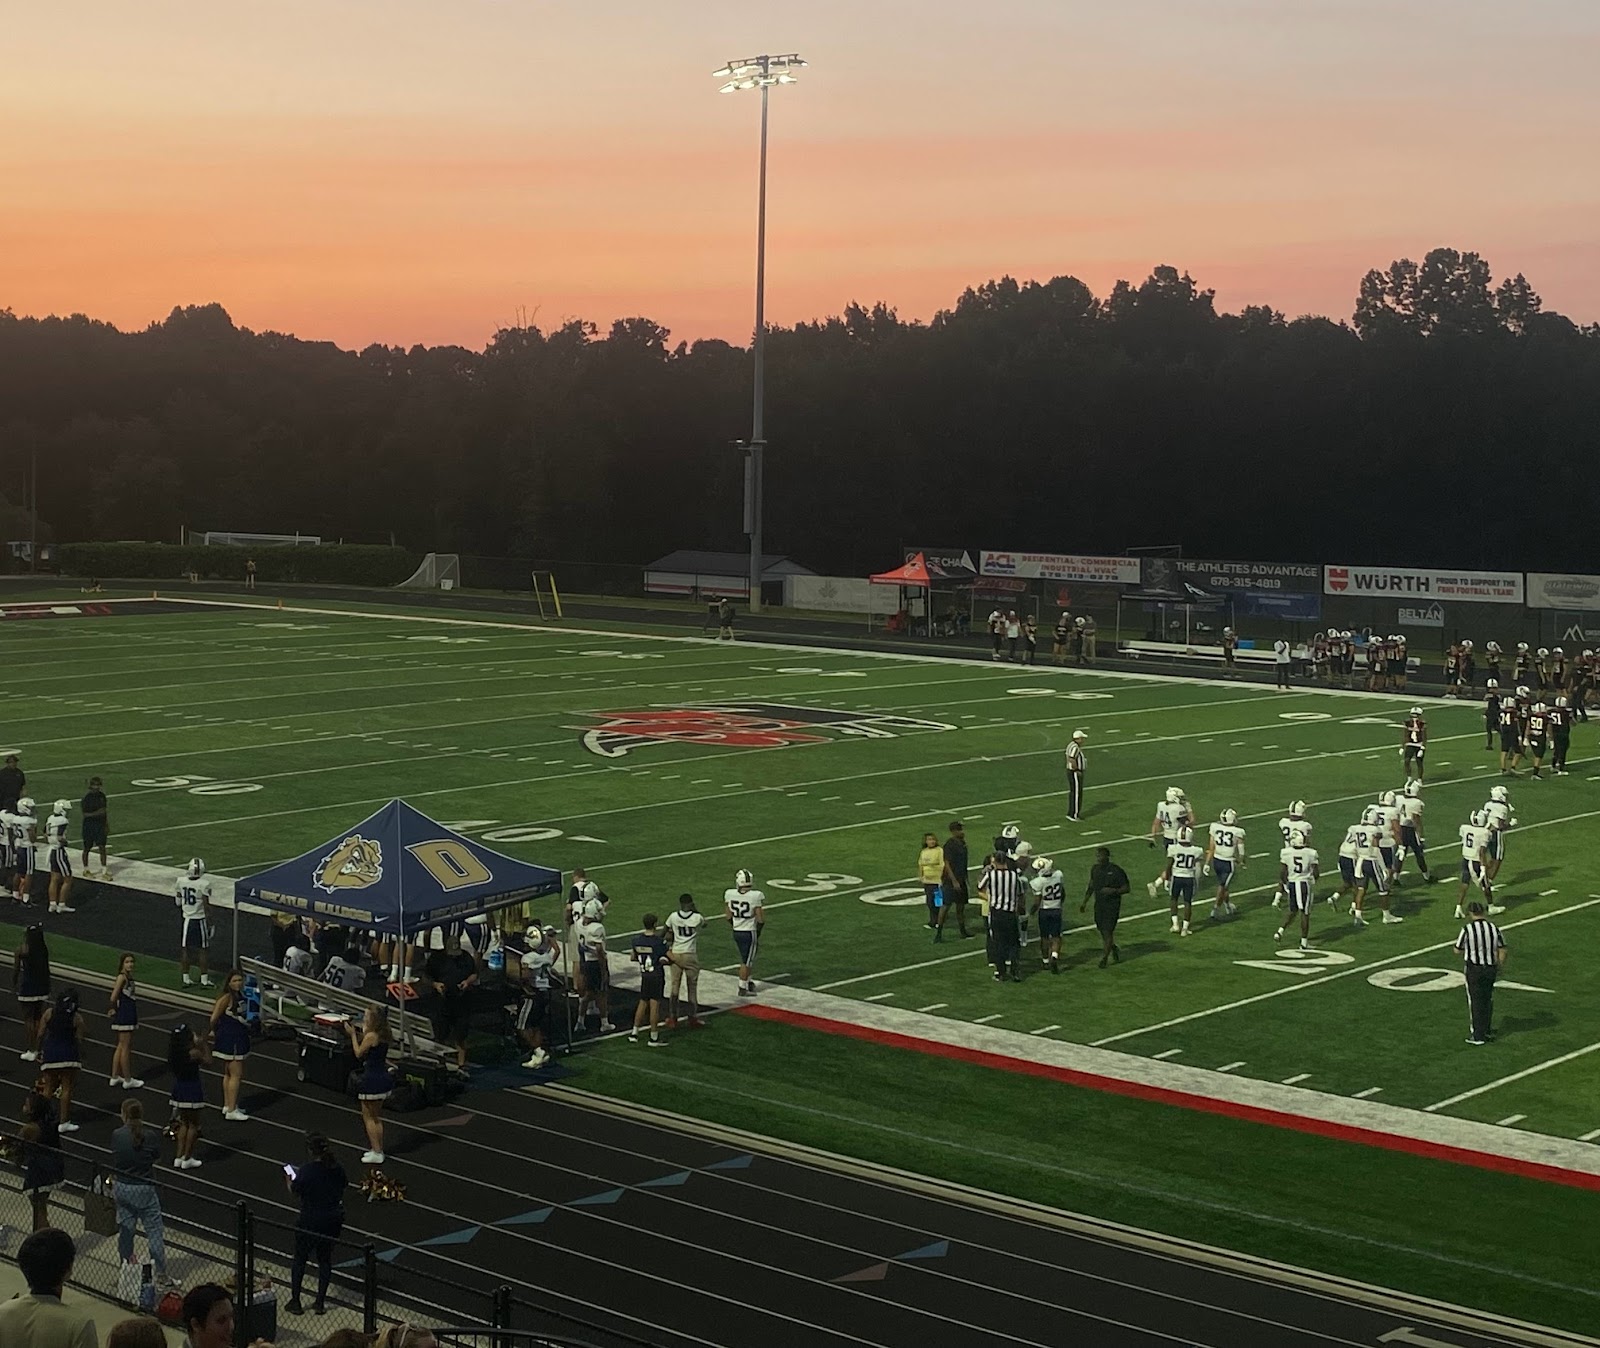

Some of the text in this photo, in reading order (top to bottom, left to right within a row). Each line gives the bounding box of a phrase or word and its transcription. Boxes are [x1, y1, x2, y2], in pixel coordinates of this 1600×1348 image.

[1022, 556, 1138, 567] RESIDENTIAL COMMERCIAL
[1041, 564, 1118, 575] INDUSTRIAL HVAC
[1176, 562, 1319, 577] THE ATHLETES ADVANTAGE
[1210, 576, 1281, 588] 678-315-4819
[1436, 577, 1458, 585] PROUD
[1470, 578, 1500, 587] SUPPORT
[1502, 580, 1516, 588] THE
[1456, 587, 1491, 595] FOOTBALL
[1530, 716, 1543, 730] 50
[1551, 712, 1562, 725] 51
[1215, 830, 1234, 847] 33
[1356, 832, 1369, 848] 12
[1466, 832, 1474, 848] 6
[1176, 853, 1196, 869] 20
[1293, 856, 1303, 873] 5
[182, 886, 197, 905] 16
[1043, 883, 1062, 901] 22
[730, 900, 751, 919] 52
[325, 963, 345, 988] 56
